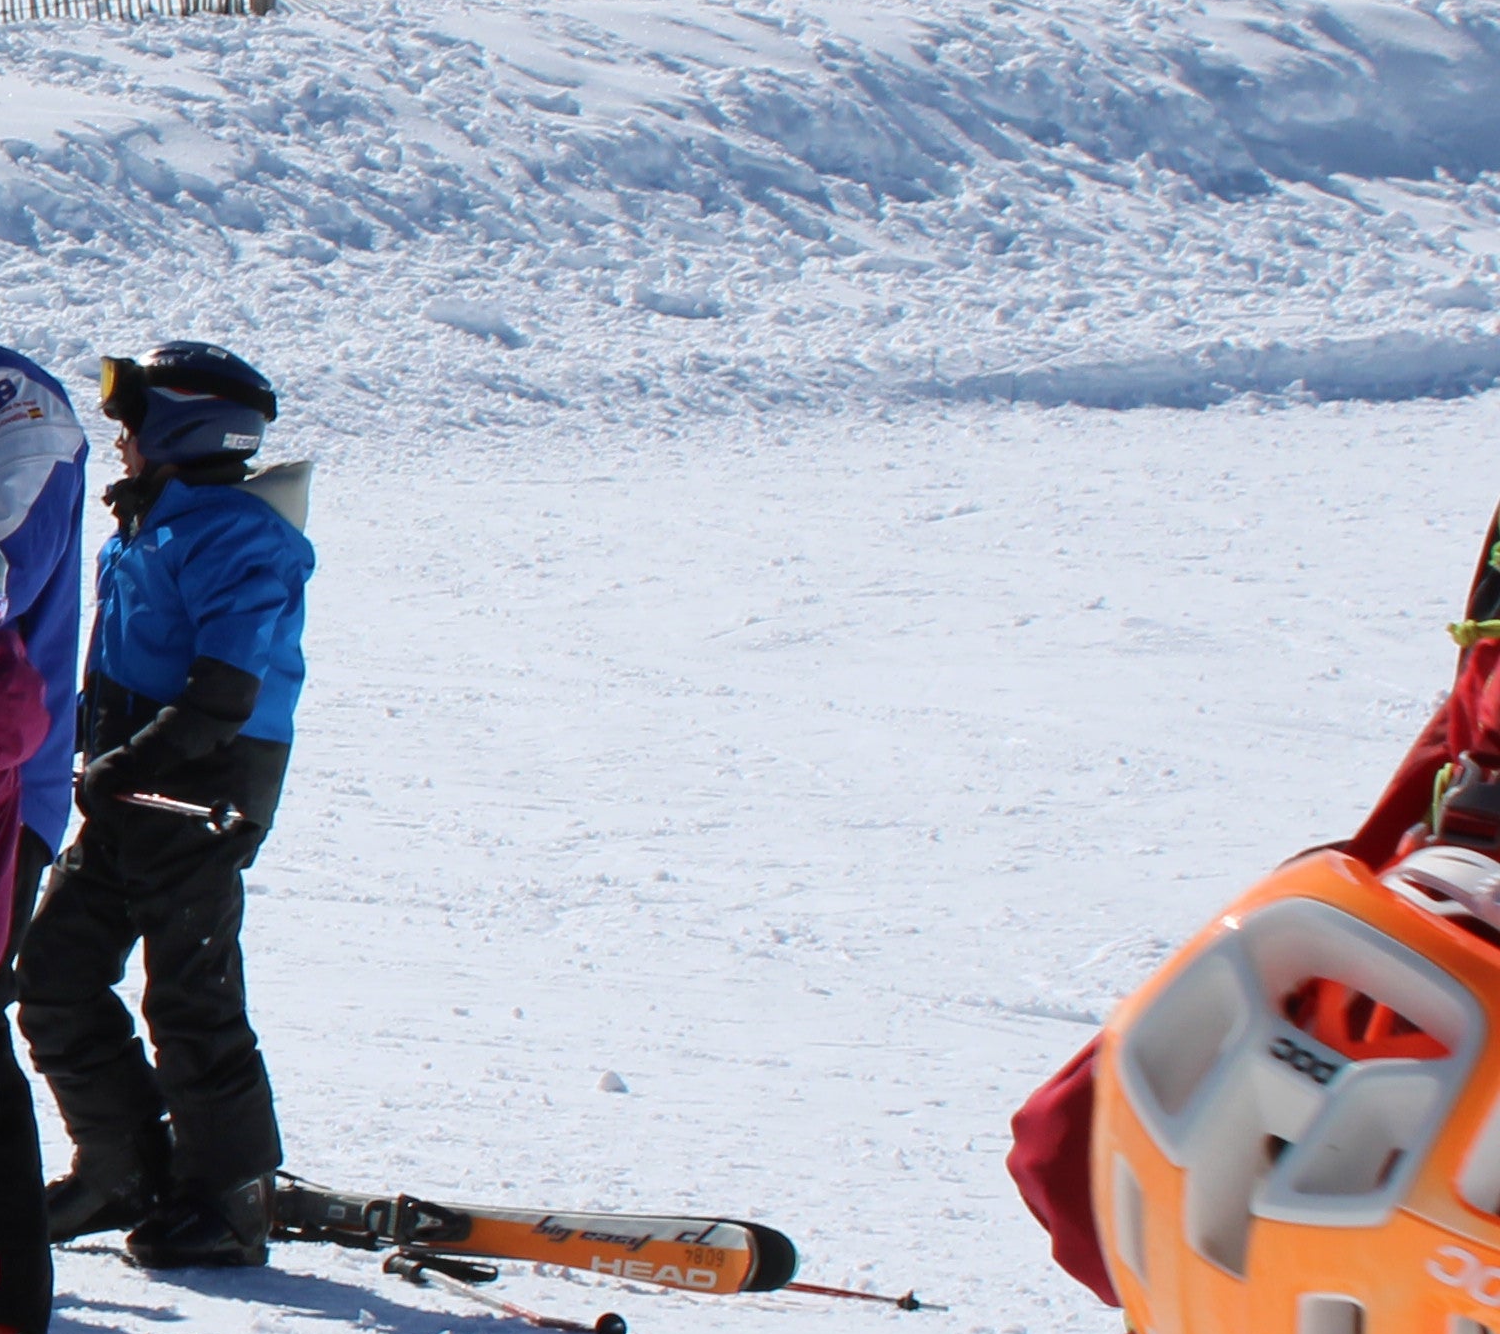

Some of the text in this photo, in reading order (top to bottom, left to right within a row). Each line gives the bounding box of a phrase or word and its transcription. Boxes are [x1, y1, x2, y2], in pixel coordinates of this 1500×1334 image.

[533, 1215, 573, 1243] big
[580, 1230, 652, 1252] easy
[590, 1256, 718, 1289] HEAD
